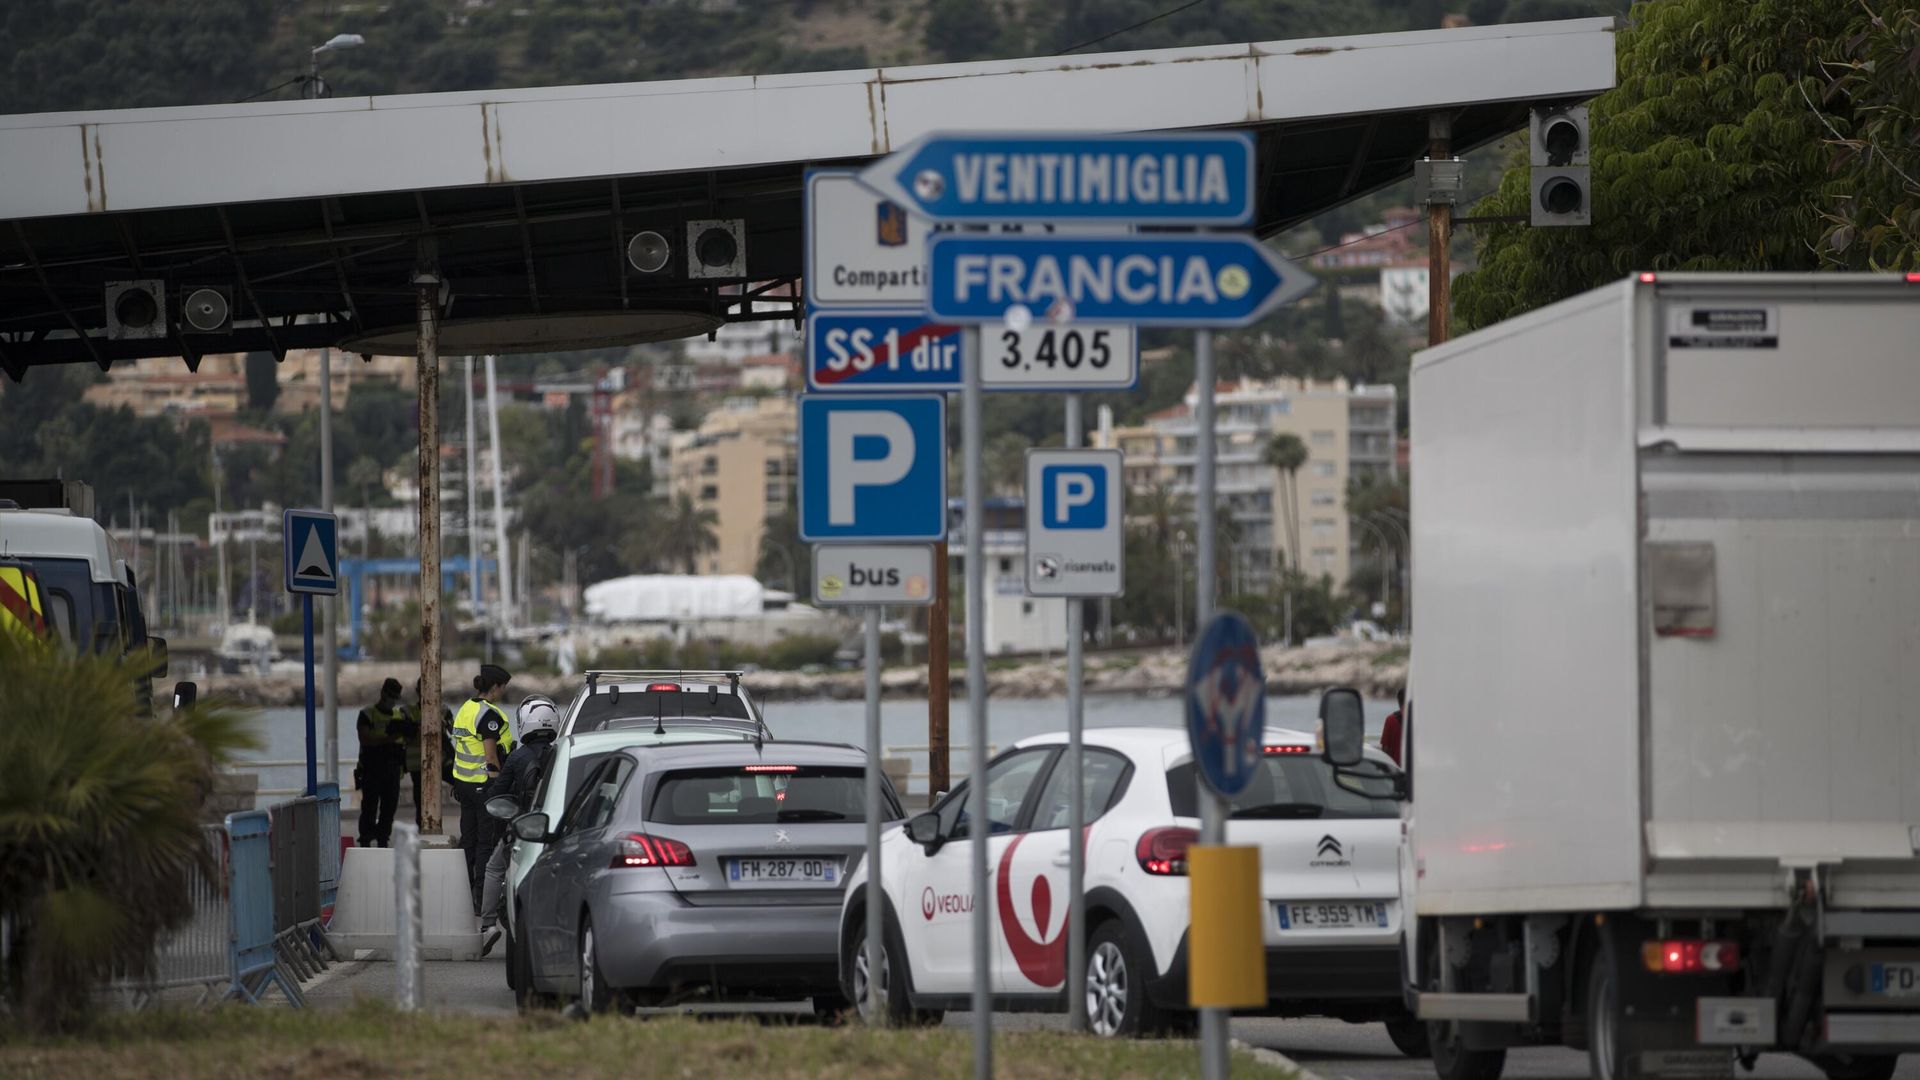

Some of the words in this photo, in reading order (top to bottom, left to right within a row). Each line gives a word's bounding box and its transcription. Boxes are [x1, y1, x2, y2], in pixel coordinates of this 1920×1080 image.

[953, 153, 1229, 204] VENTIMIGLIA
[953, 253, 1218, 303] FRANCIA
[910, 334, 957, 371] dir
[828, 410, 916, 526] P
[1055, 473, 1094, 522] P
[849, 562, 900, 587] bus
[1291, 905, 1376, 924] FE-959-TM
